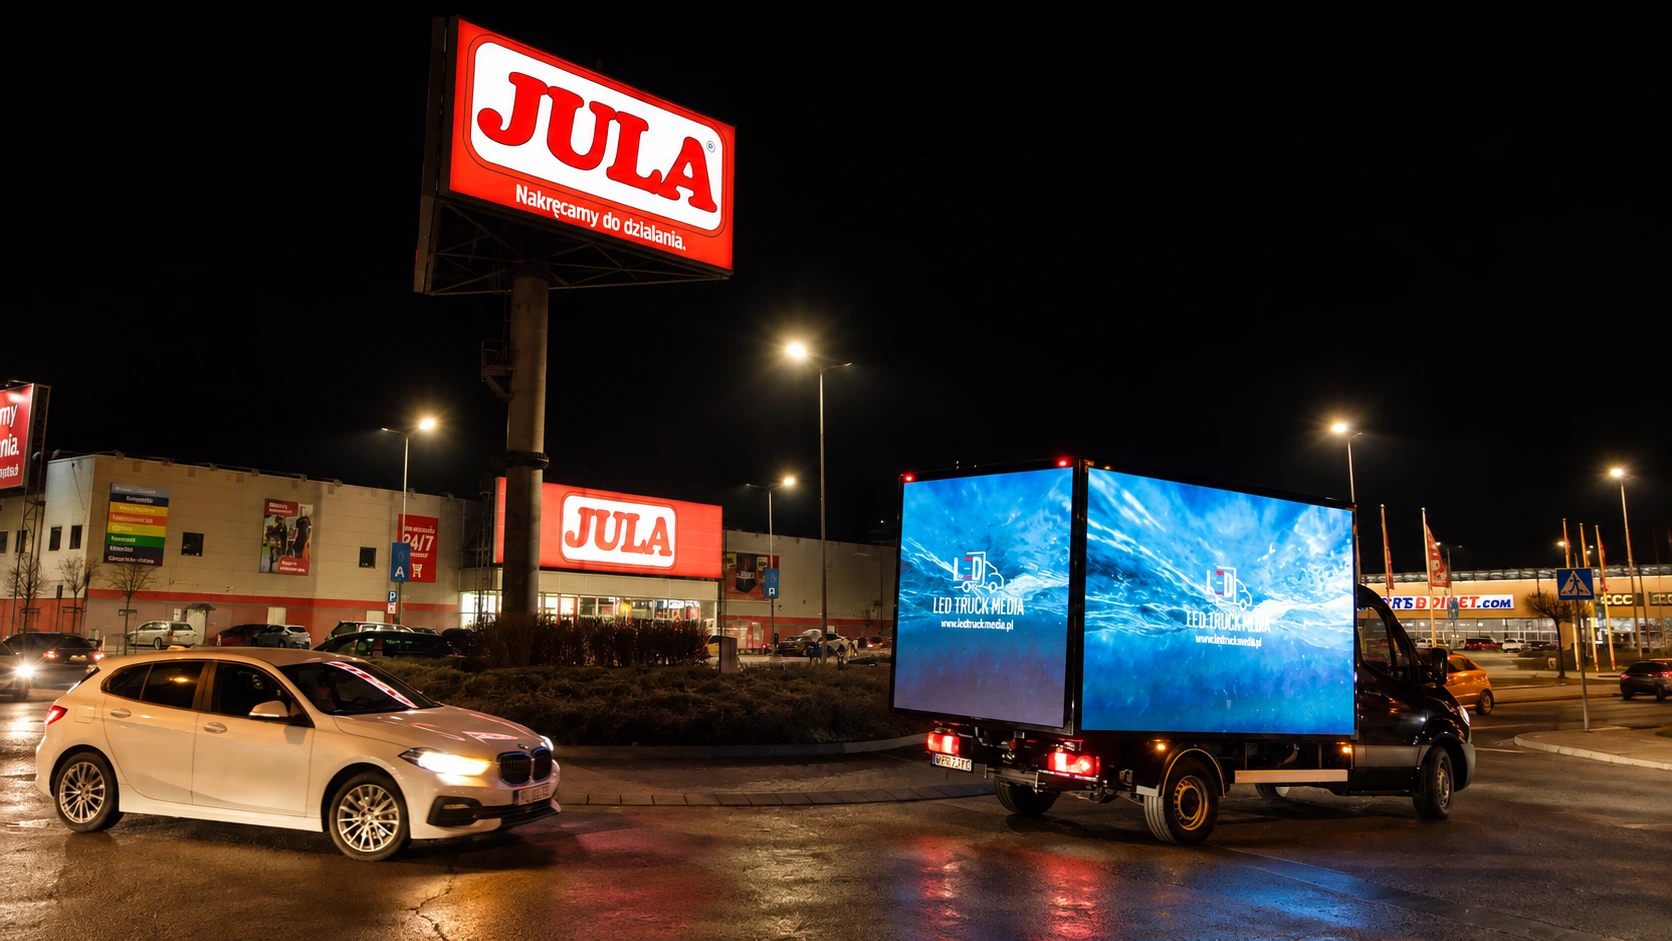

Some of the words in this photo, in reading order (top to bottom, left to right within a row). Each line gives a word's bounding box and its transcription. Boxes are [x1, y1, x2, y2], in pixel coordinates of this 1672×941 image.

[477, 71, 717, 213] JULA
[516, 184, 599, 228] Nakręcamy
[603, 212, 620, 231] do
[0, 433, 19, 457] nia.
[565, 507, 673, 557] JULA
[395, 566, 405, 578] A
[389, 591, 396, 602] P
[933, 597, 952, 614] LED
[954, 597, 989, 615] TRUCK
[991, 597, 1025, 615] MEDIA
[1600, 594, 1633, 605] CCC
[1208, 611, 1239, 632] TRUCK
